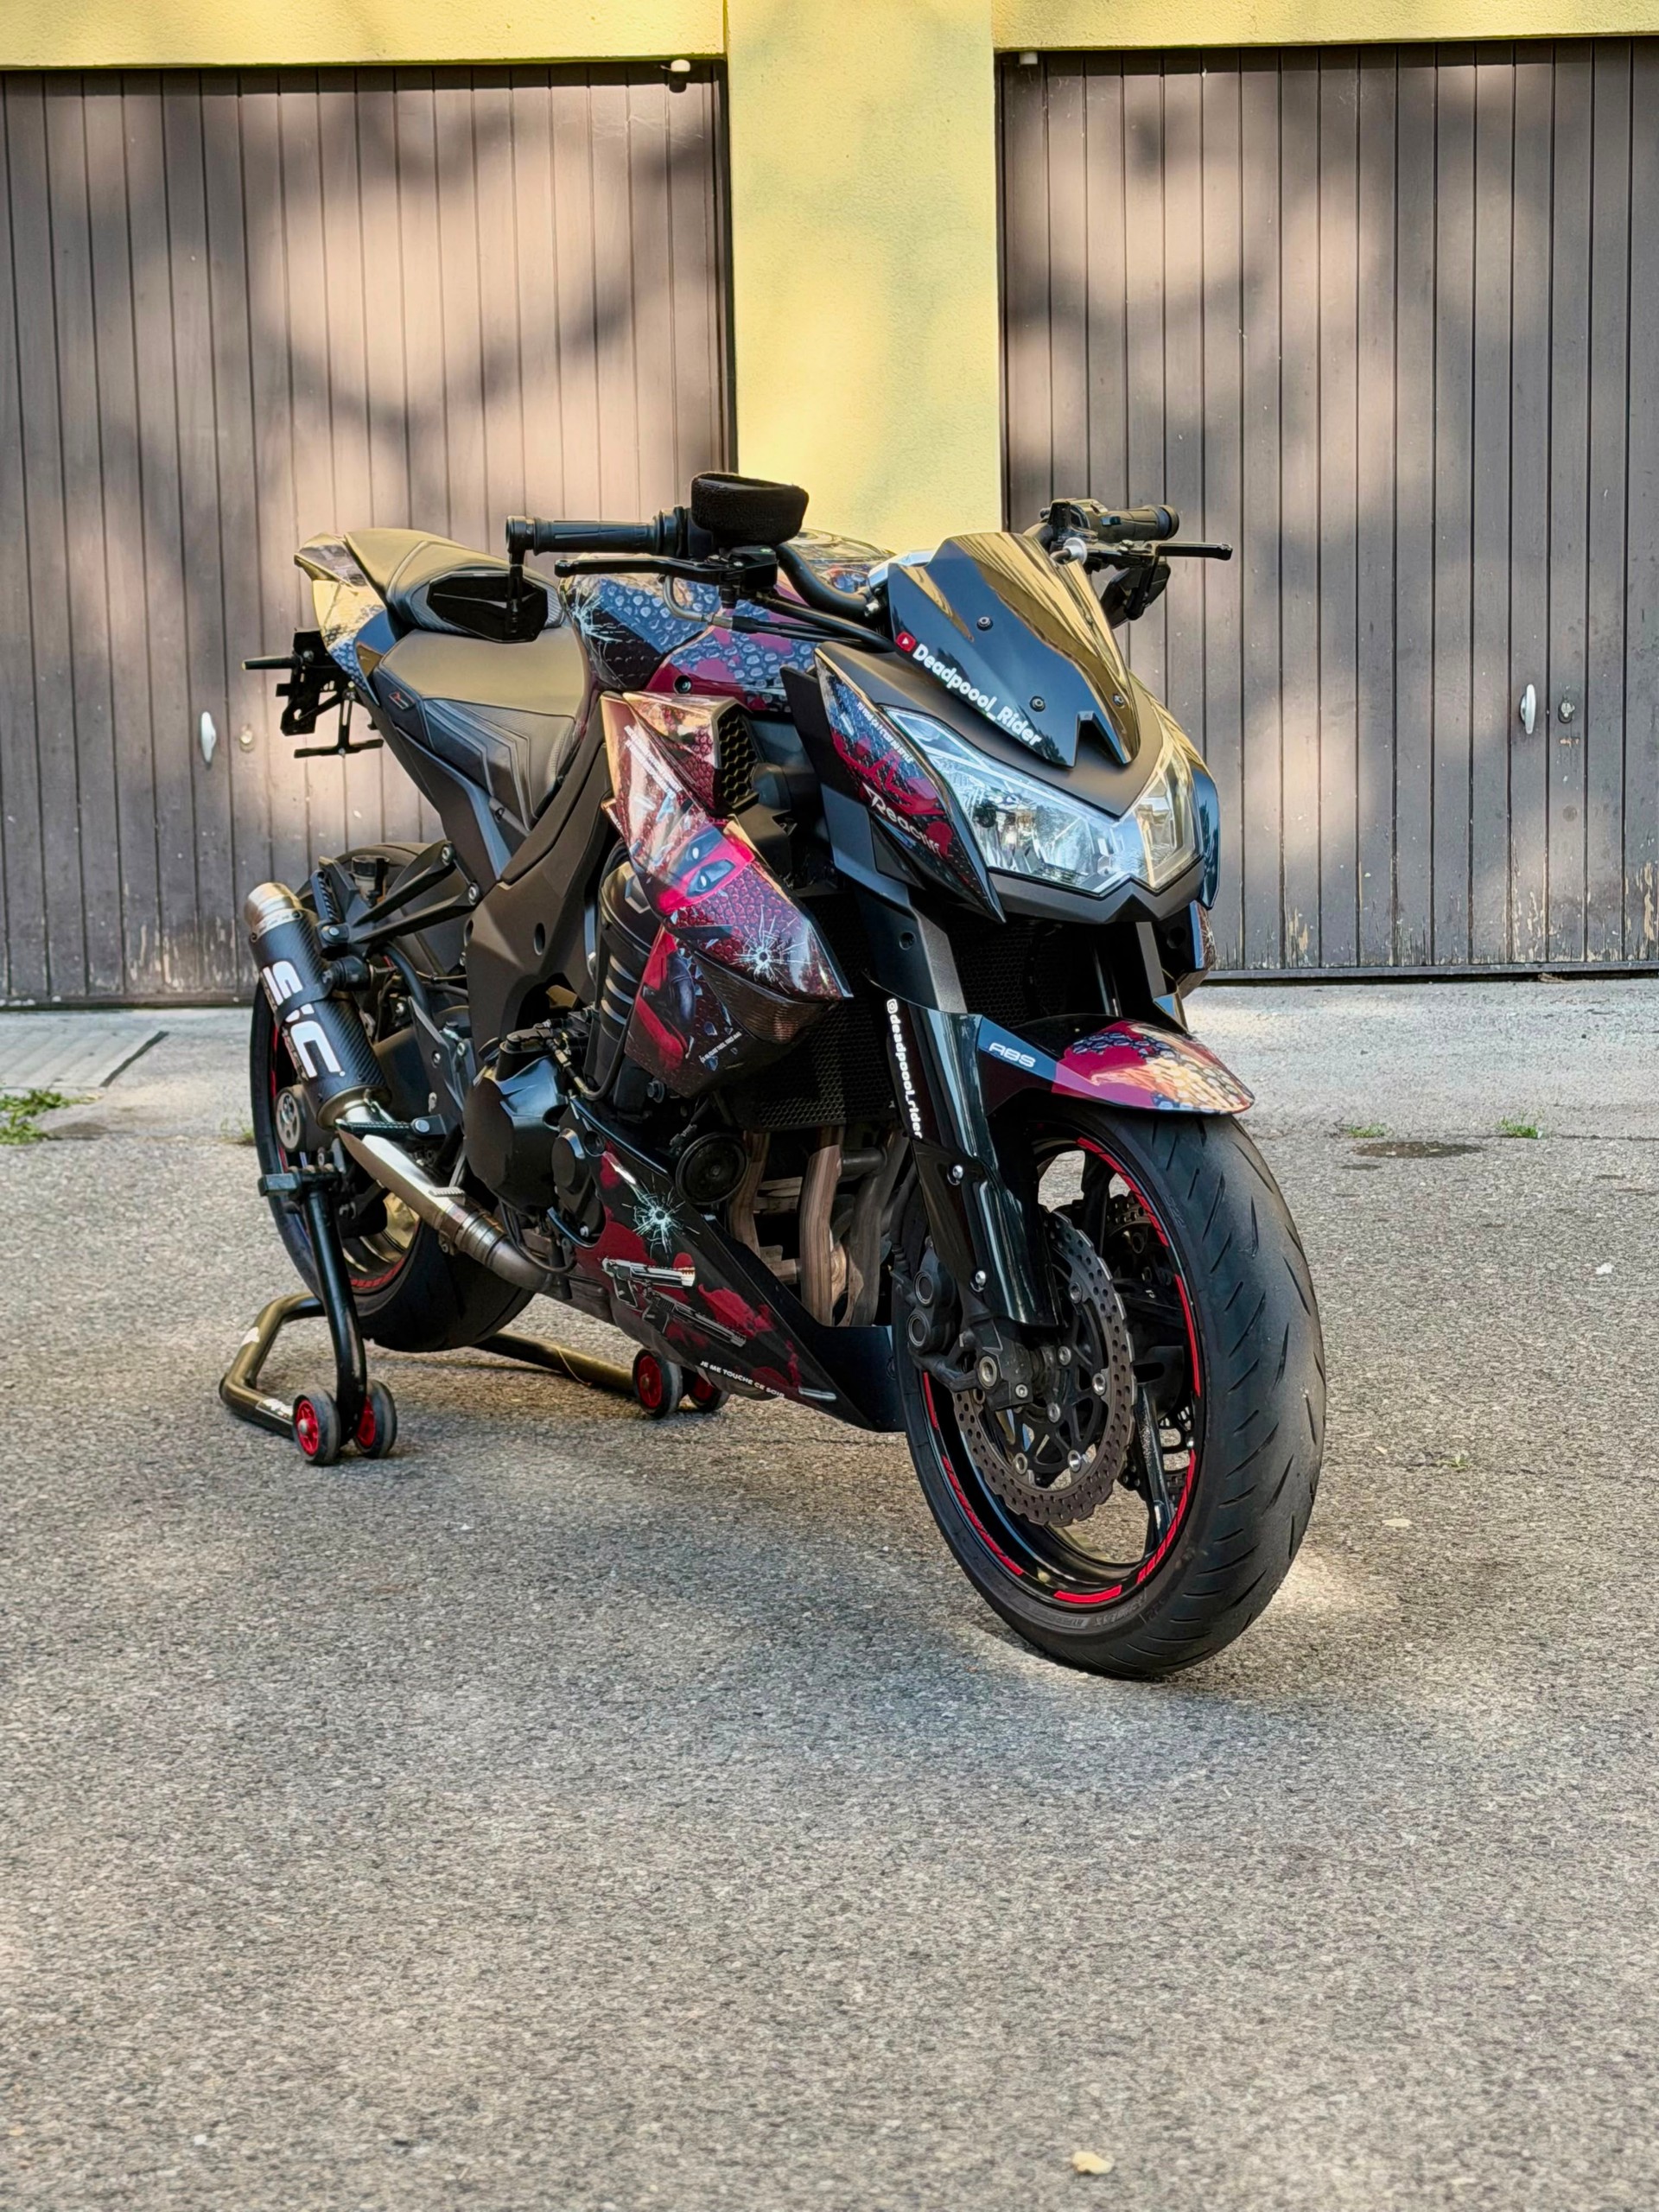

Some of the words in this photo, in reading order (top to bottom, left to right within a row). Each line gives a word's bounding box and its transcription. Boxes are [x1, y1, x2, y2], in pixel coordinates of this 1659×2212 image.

[912, 644, 1042, 746] Deadpoool_Rider
[889, 1014, 923, 1140] deadpoool_rider
[988, 1042, 1036, 1068] ABS
[723, 1370, 753, 1385] TOUCHE
[754, 1382, 766, 1390] CE
